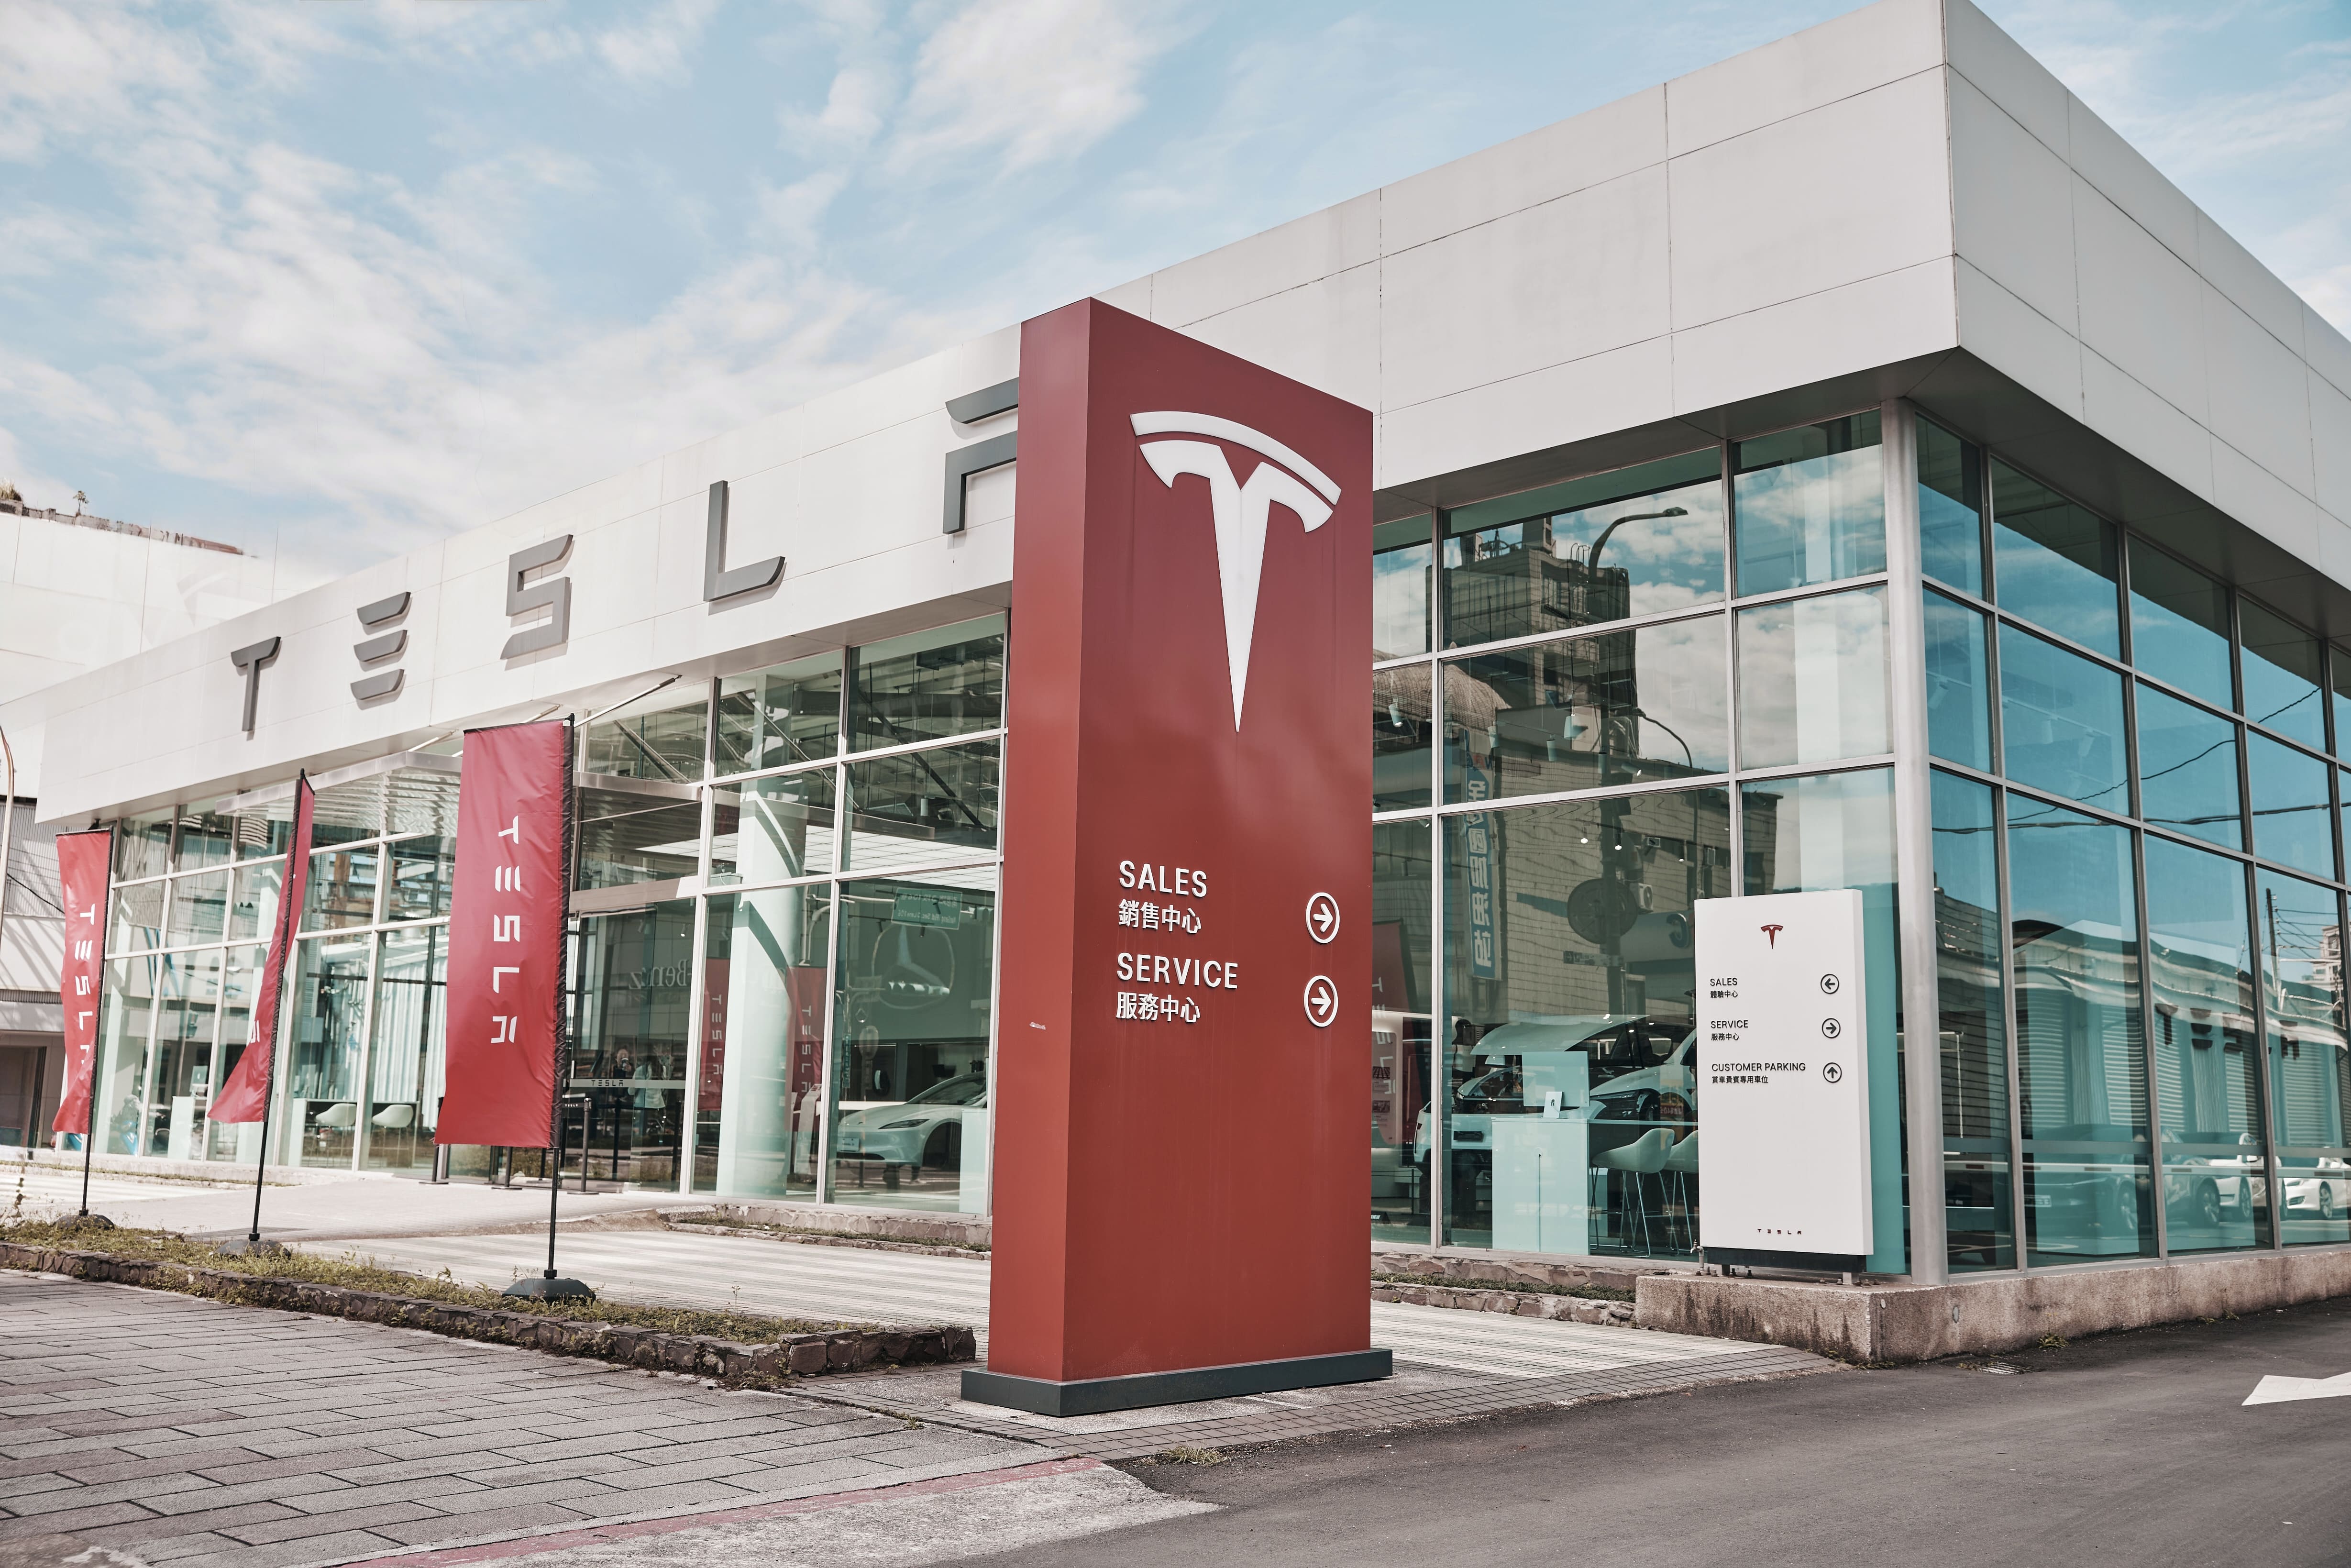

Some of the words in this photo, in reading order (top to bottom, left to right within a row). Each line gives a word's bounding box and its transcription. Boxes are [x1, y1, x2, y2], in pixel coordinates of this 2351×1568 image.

[1119, 860, 1208, 898] SALES
[491, 815, 521, 1044] TESLA
[1118, 899, 1202, 934] 銷售中心
[1116, 952, 1238, 989] SERVICE
[1710, 978, 1737, 986] SALES
[1115, 992, 1201, 1023] 服務中心
[1711, 990, 1738, 998] 體驗中心
[712, 994, 723, 1075] TESLA
[1711, 1020, 1749, 1028] SERVICE
[1711, 1033, 1740, 1041] 服務中心
[802, 1005, 811, 1092] TESLA
[1711, 1063, 1762, 1071] CUSTOMER
[1765, 1062, 1806, 1071] PARKING
